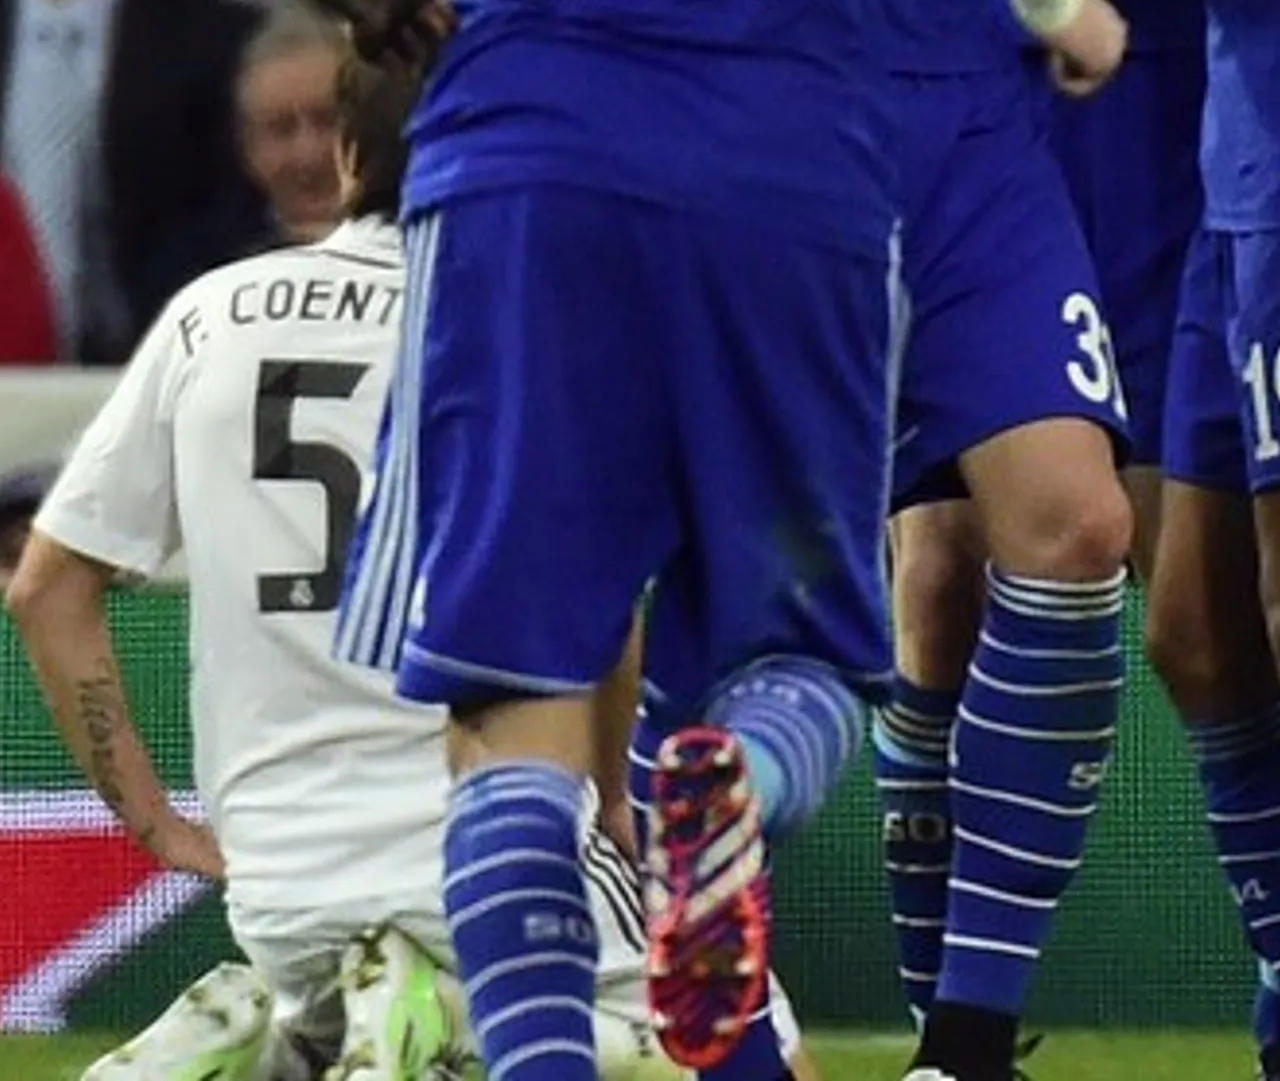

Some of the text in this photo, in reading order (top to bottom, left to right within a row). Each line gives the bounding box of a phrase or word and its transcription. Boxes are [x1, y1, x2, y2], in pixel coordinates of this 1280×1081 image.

[178, 279, 403, 357] F. COENT
[252, 358, 375, 613] 5
